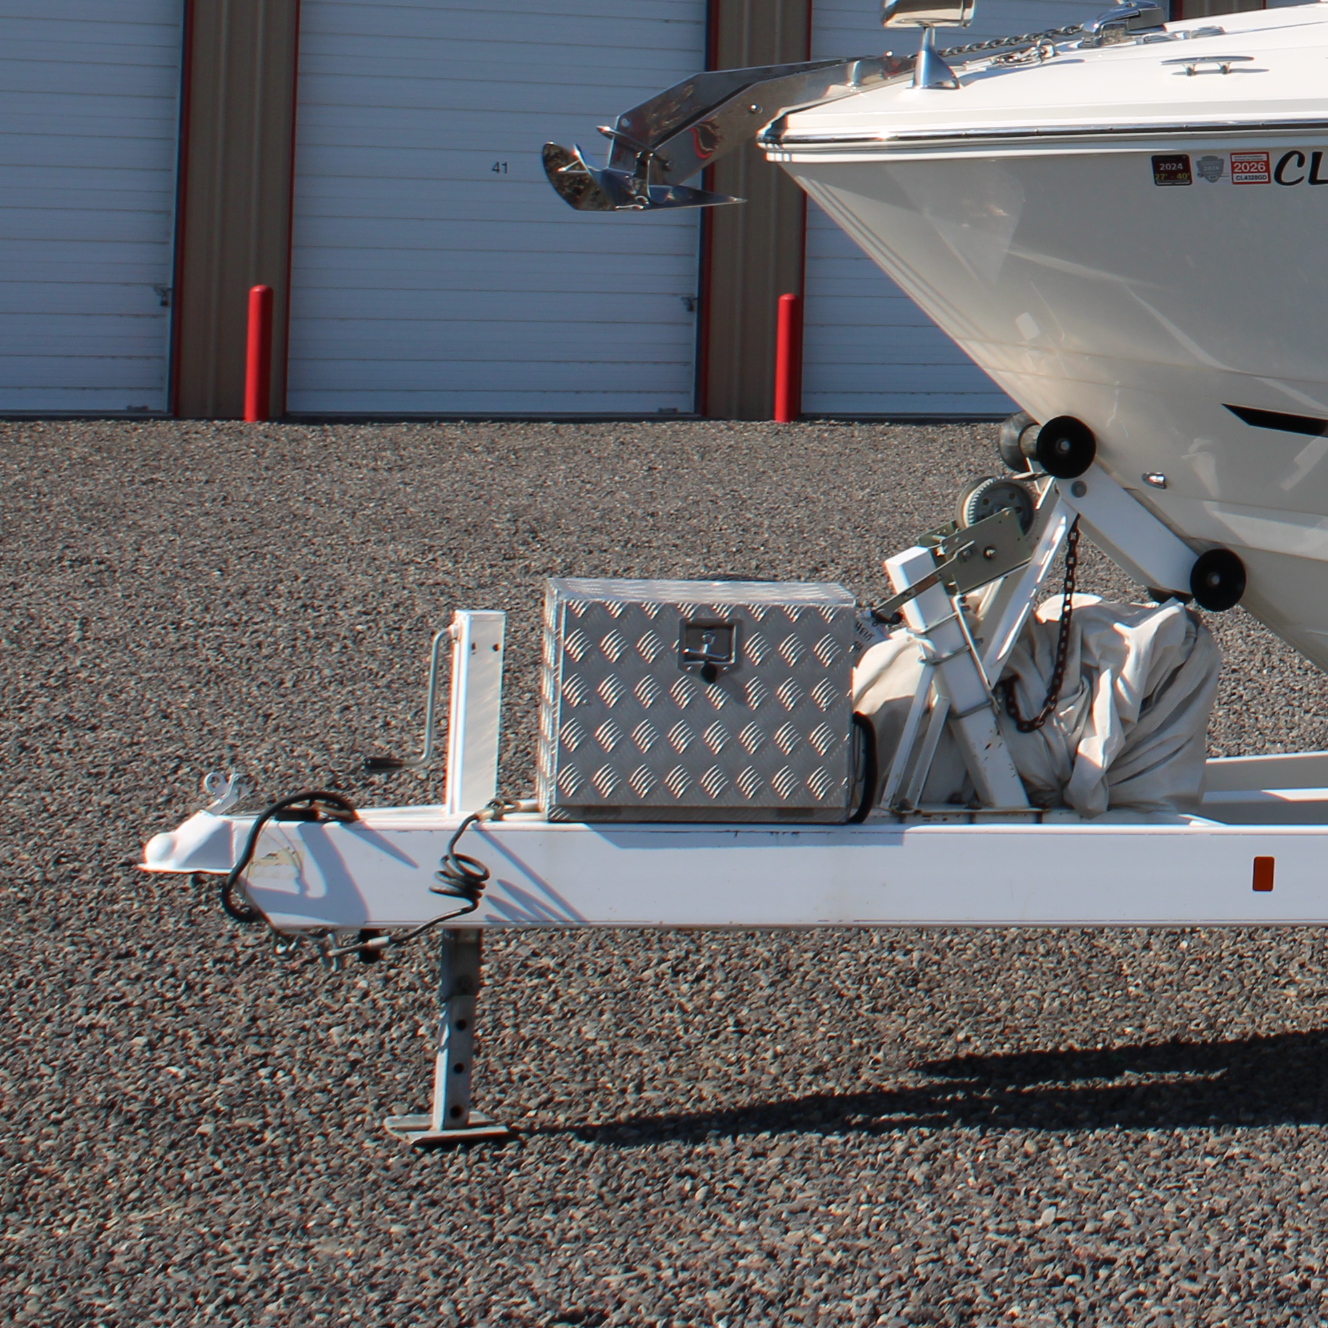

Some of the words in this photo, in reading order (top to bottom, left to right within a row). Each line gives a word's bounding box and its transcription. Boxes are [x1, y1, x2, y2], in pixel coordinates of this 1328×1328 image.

[491, 161, 508, 174] 41
[1159, 163, 1184, 171] 2024
[1233, 162, 1266, 172] 2026
